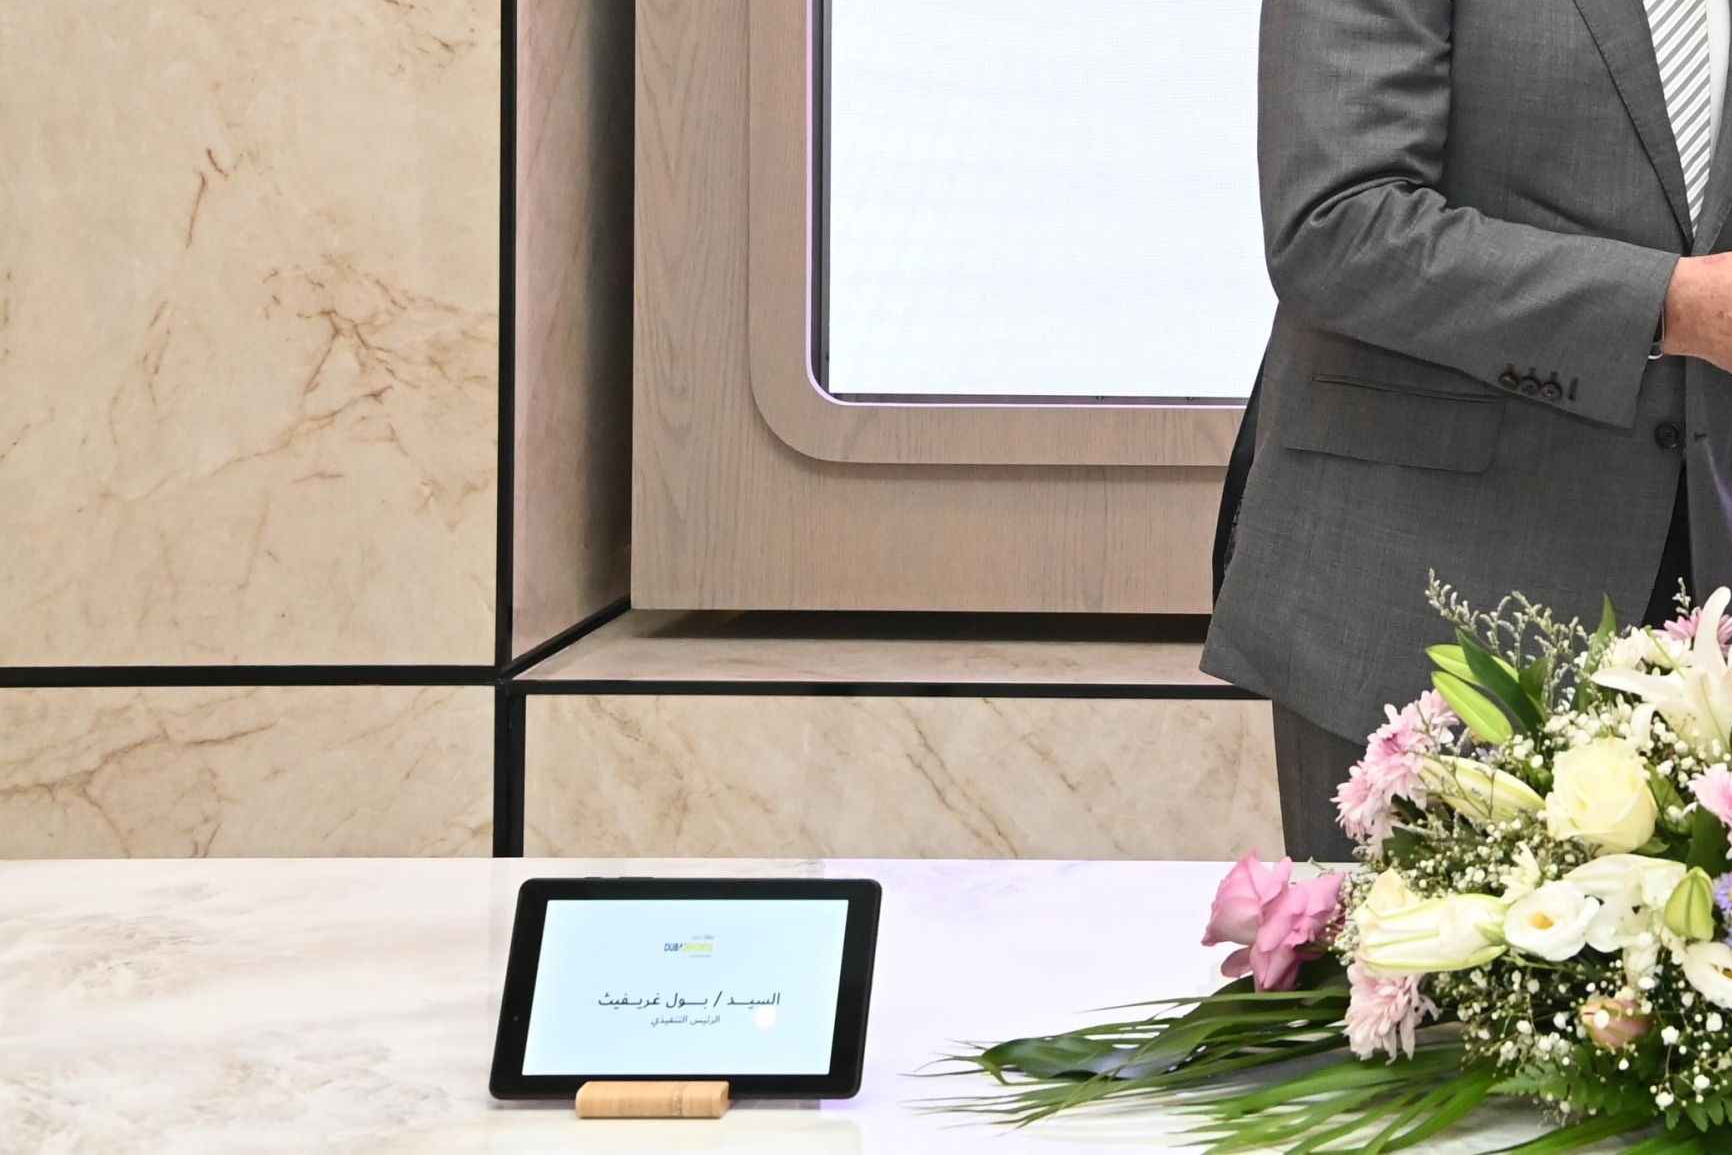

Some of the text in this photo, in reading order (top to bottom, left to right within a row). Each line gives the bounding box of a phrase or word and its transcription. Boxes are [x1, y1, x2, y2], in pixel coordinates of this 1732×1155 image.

[598, 992, 661, 1009] غريفيث
[666, 992, 708, 1009] بول
[727, 992, 781, 1009] السيد
